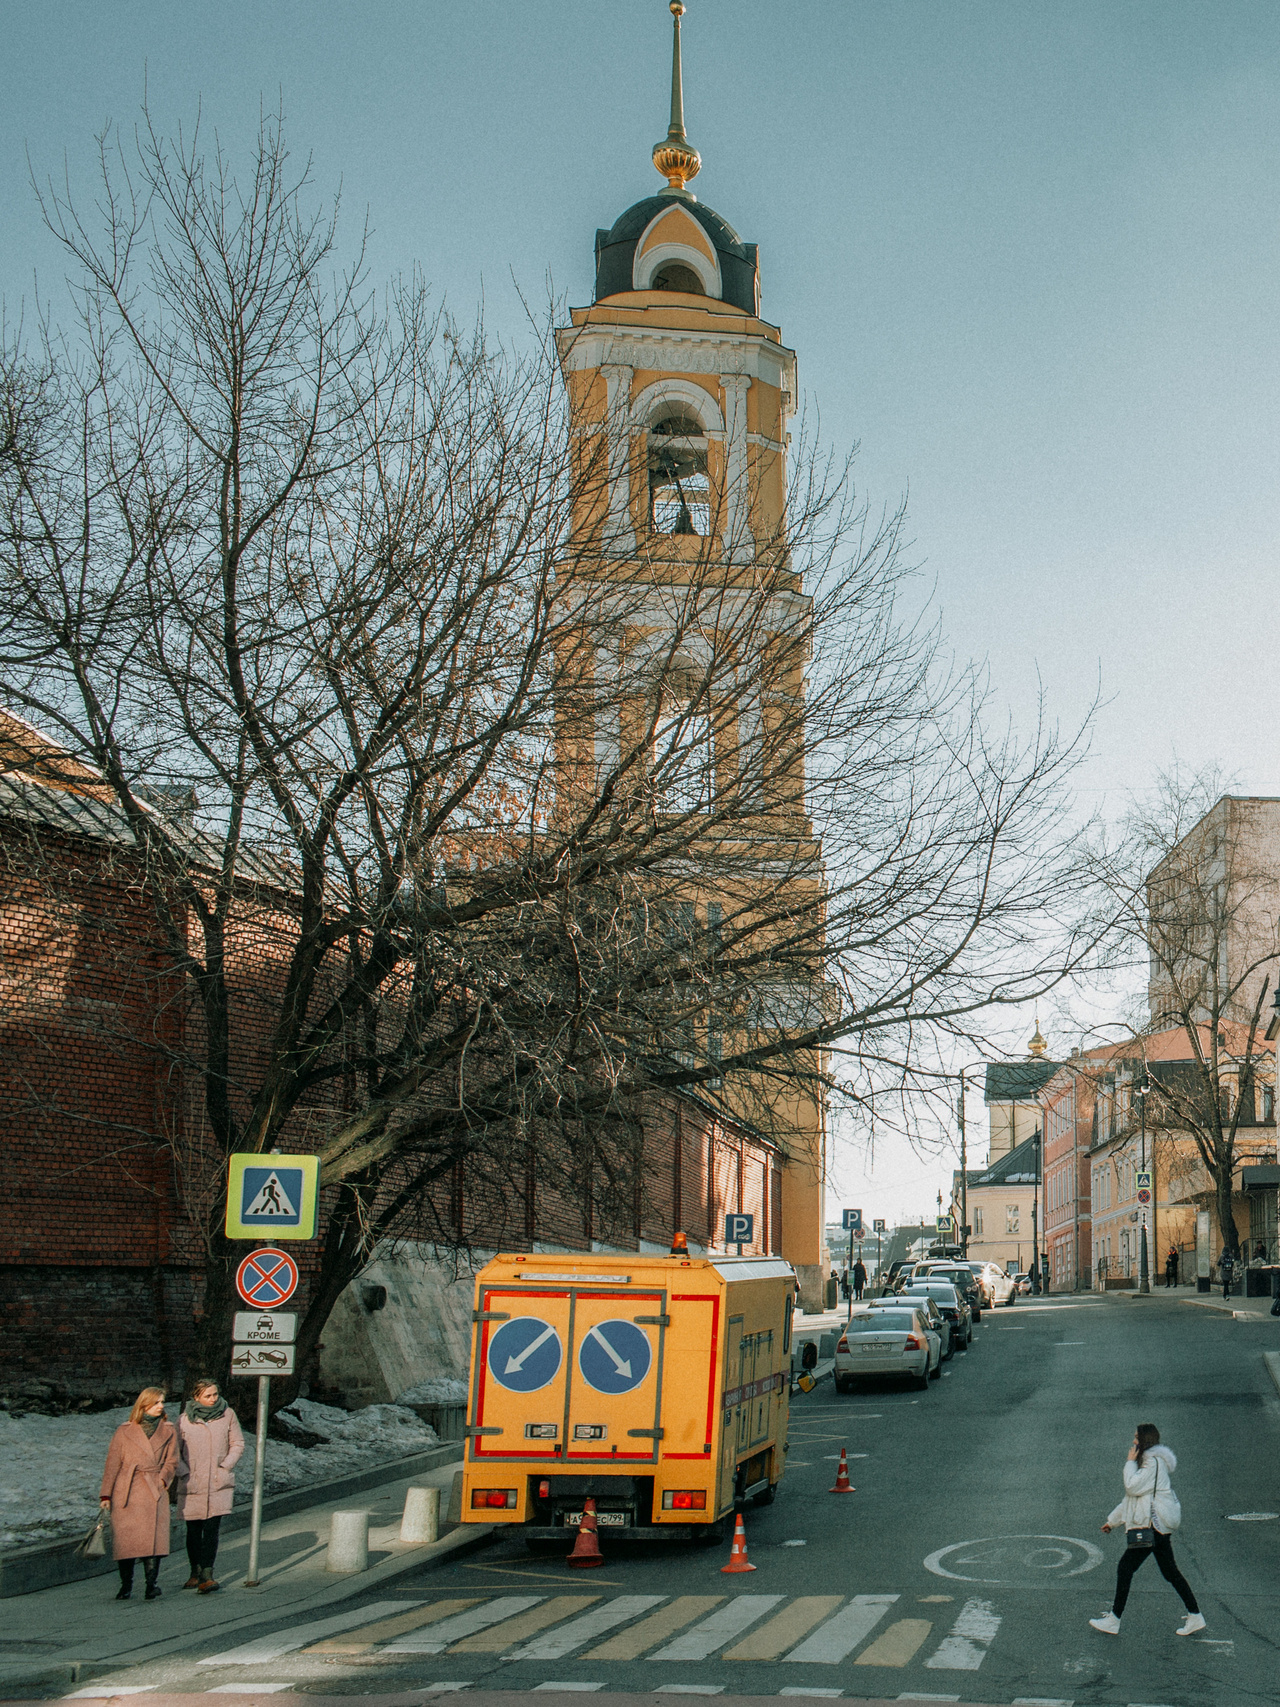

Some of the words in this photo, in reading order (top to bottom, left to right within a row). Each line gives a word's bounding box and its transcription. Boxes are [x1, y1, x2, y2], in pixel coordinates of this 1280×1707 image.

[847, 1210, 859, 1228] P
[733, 1216, 749, 1241] P
[247, 1331, 281, 1340] КРОМЕ
